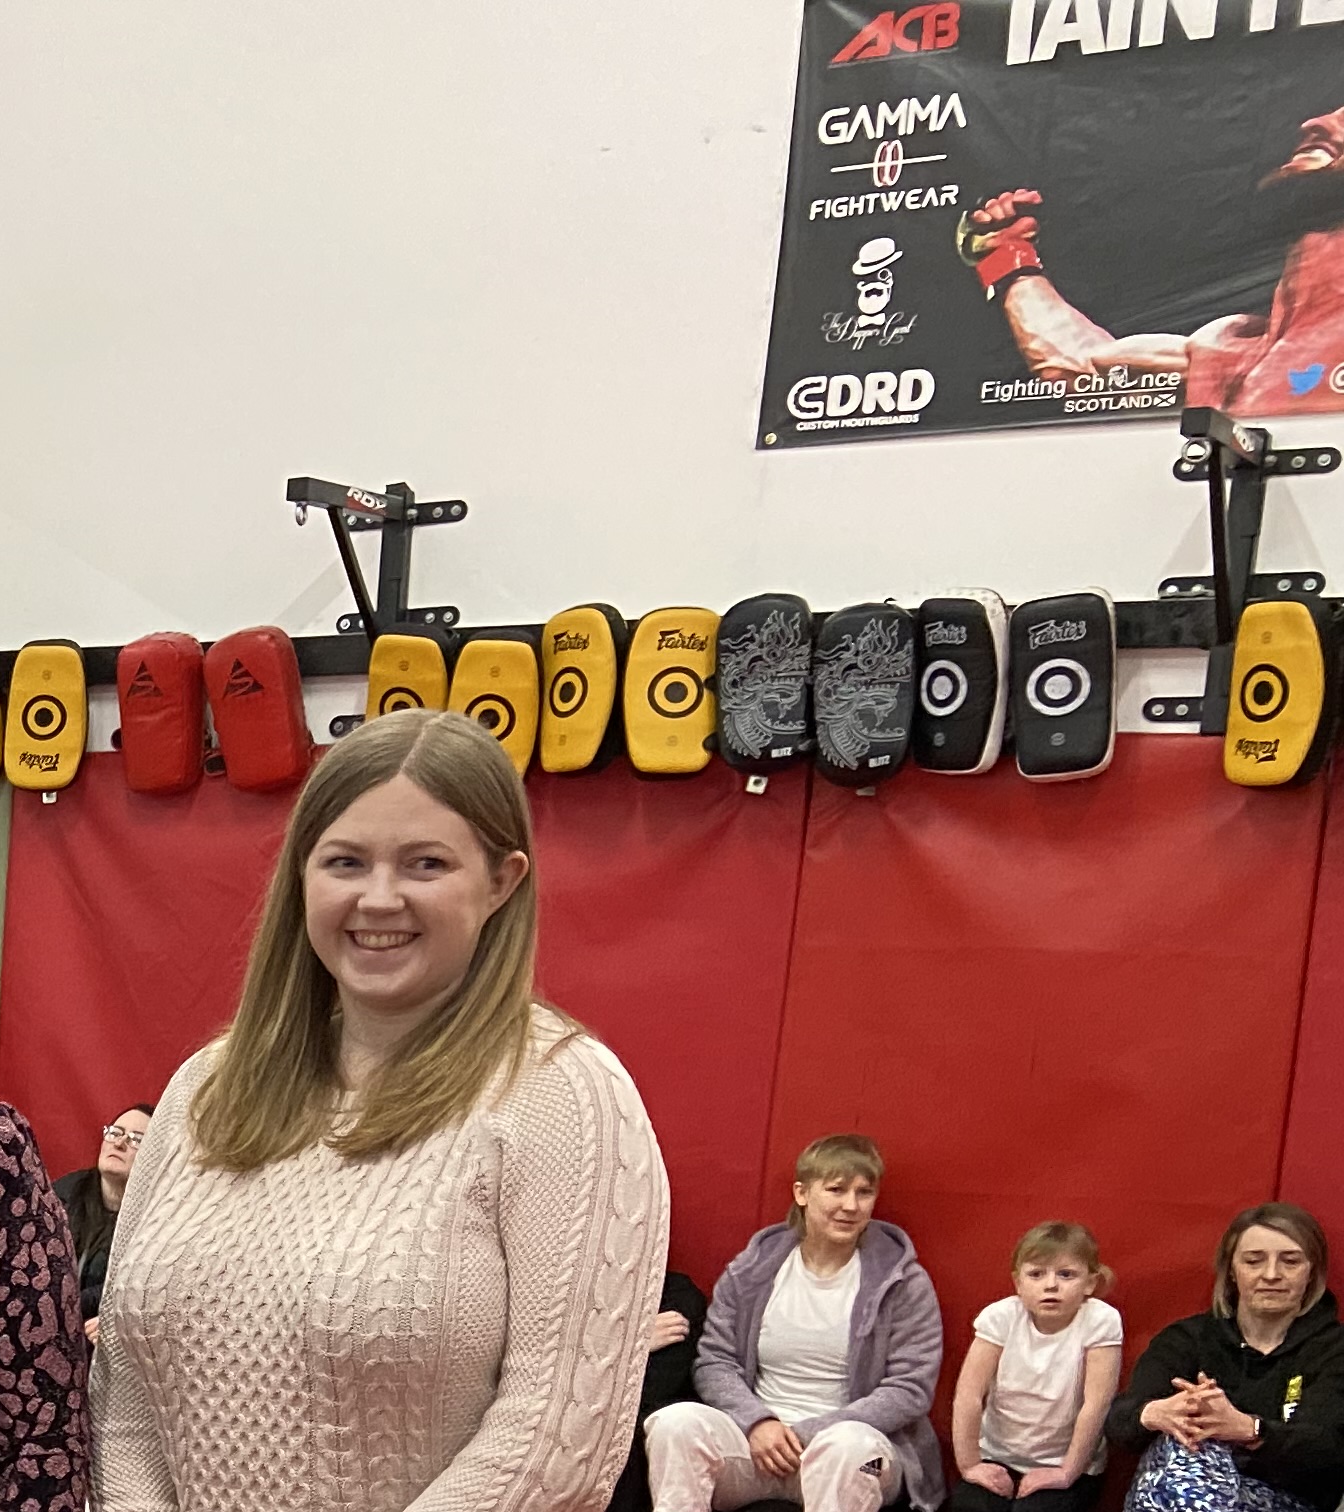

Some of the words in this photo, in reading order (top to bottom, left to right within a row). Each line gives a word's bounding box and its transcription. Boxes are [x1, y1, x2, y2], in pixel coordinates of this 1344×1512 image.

[831, 2, 961, 64] ACB
[817, 92, 967, 146] GAMMA
[809, 184, 959, 221] FIGHTWEAR
[980, 377, 1067, 402] Fighting
[1064, 395, 1153, 413] SCOTLAND
[795, 418, 840, 432] CUSTOM
[840, 413, 921, 428] MOUTHGUARDS
[657, 627, 709, 652] Fairtex
[1028, 619, 1087, 650] Fairtex
